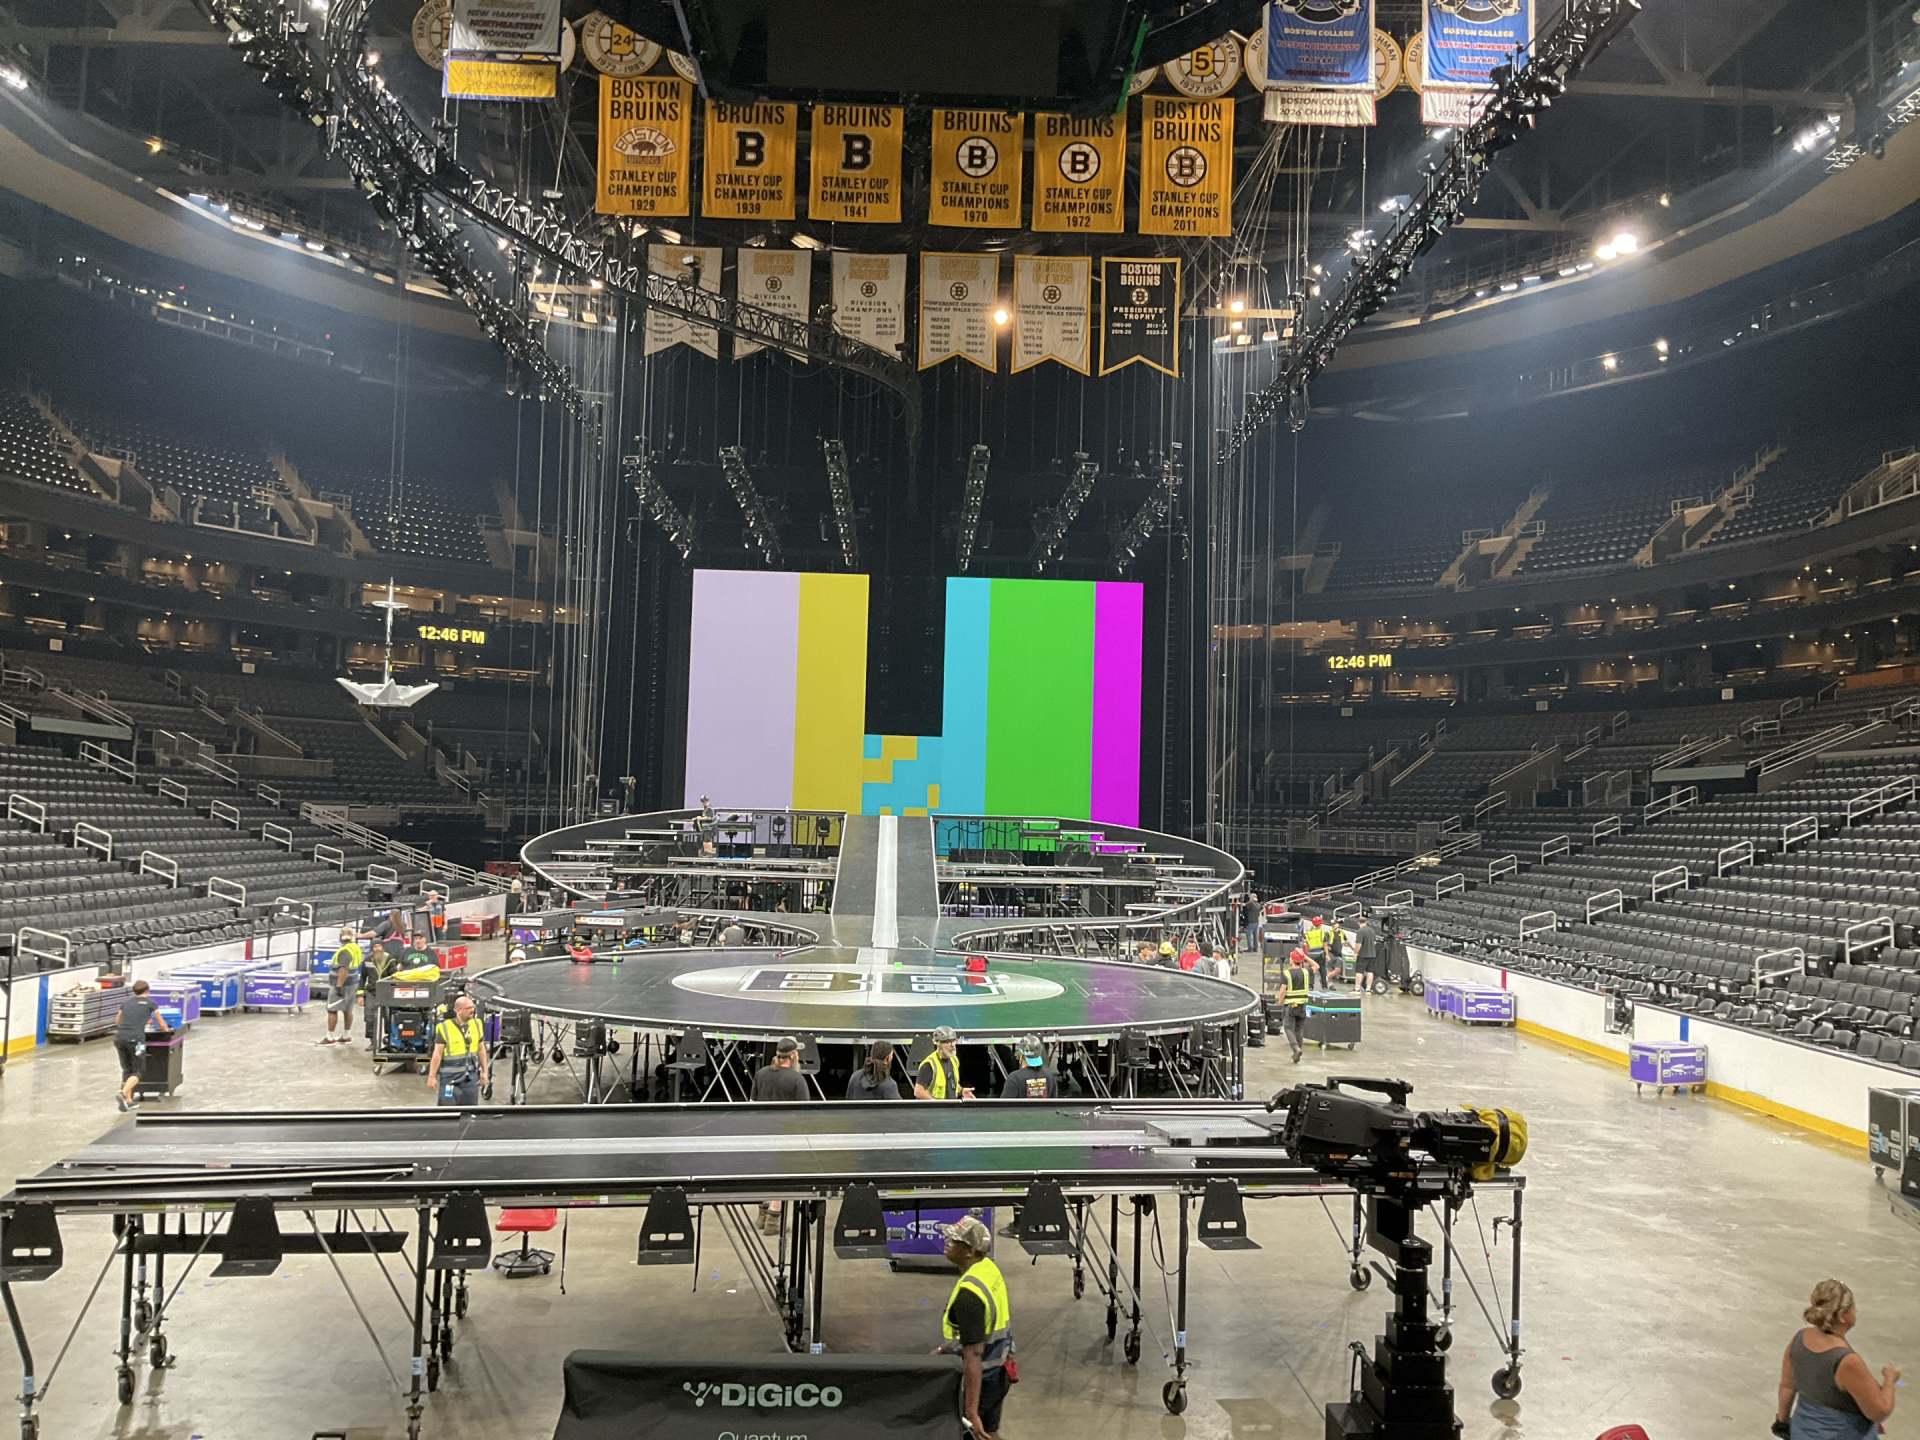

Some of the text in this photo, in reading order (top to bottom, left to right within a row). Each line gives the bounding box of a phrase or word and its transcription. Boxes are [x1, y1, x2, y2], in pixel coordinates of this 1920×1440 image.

[492, 10, 546, 20] HAMPSHIRE
[476, 30, 535, 40] PROVIDENCE
[1284, 28, 1317, 36] BOSTON
[1444, 28, 1514, 38] BOSTON COLLEGE
[614, 34, 632, 46] 24
[1277, 40, 1360, 51] BOSTON UNIVERSITY
[1437, 40, 1470, 48] BOSTON
[1195, 51, 1210, 70] 5
[1458, 56, 1499, 64] HARVARD
[510, 69, 544, 80] College
[489, 80, 536, 90] Champions
[612, 80, 680, 100] BOSTON
[1281, 98, 1358, 106] BOSTON COLLEGE
[611, 100, 679, 121] BRUINS
[717, 105, 784, 124] BRUINS
[1154, 101, 1222, 120] BOSTON
[1304, 108, 1360, 117] CHAMPIONS
[1438, 109, 1460, 118] 2026
[824, 107, 892, 128] BRUINS
[944, 111, 1012, 134] BRUINS
[1047, 117, 1114, 138] BRUINS
[1154, 122, 1220, 142] BRUINS
[616, 127, 674, 153] BOSTON
[735, 130, 765, 168] B
[842, 133, 872, 170] B
[968, 146, 986, 168] B
[1070, 151, 1089, 174] B
[1178, 156, 1194, 177] B
[610, 170, 676, 182] STANLEY CUP
[716, 174, 782, 186] STANLEY CUP
[822, 176, 889, 190] STANLEY CUP
[942, 182, 1009, 195] STANLEY CUP
[608, 184, 676, 197] CHAMPIONS
[714, 188, 782, 200] CHAMPIONS
[1046, 188, 1112, 200] STANLEY CUP
[821, 190, 890, 204] CHAMPIONS
[942, 196, 1009, 210] CHAMPIONS
[1152, 191, 1218, 204] STANLEY CUP
[631, 200, 654, 210] 1929
[736, 202, 761, 214] 1939
[1044, 202, 1112, 214] CHAMPIONS
[844, 206, 867, 218] 1941
[964, 210, 988, 222] 1970
[1152, 205, 1218, 218] CHAMPIONS
[1066, 216, 1090, 227] 1972
[1174, 220, 1196, 231] 2011
[1034, 262, 1072, 273] BOSTON
[1121, 264, 1160, 274] BOSTON
[1033, 273, 1072, 284] BRUINS
[1120, 275, 1160, 286] BRUINS
[417, 626, 485, 644] 12:46 PM
[1328, 654, 1392, 668] 12:46 PM
[722, 1383, 843, 1407] DiGiCo
